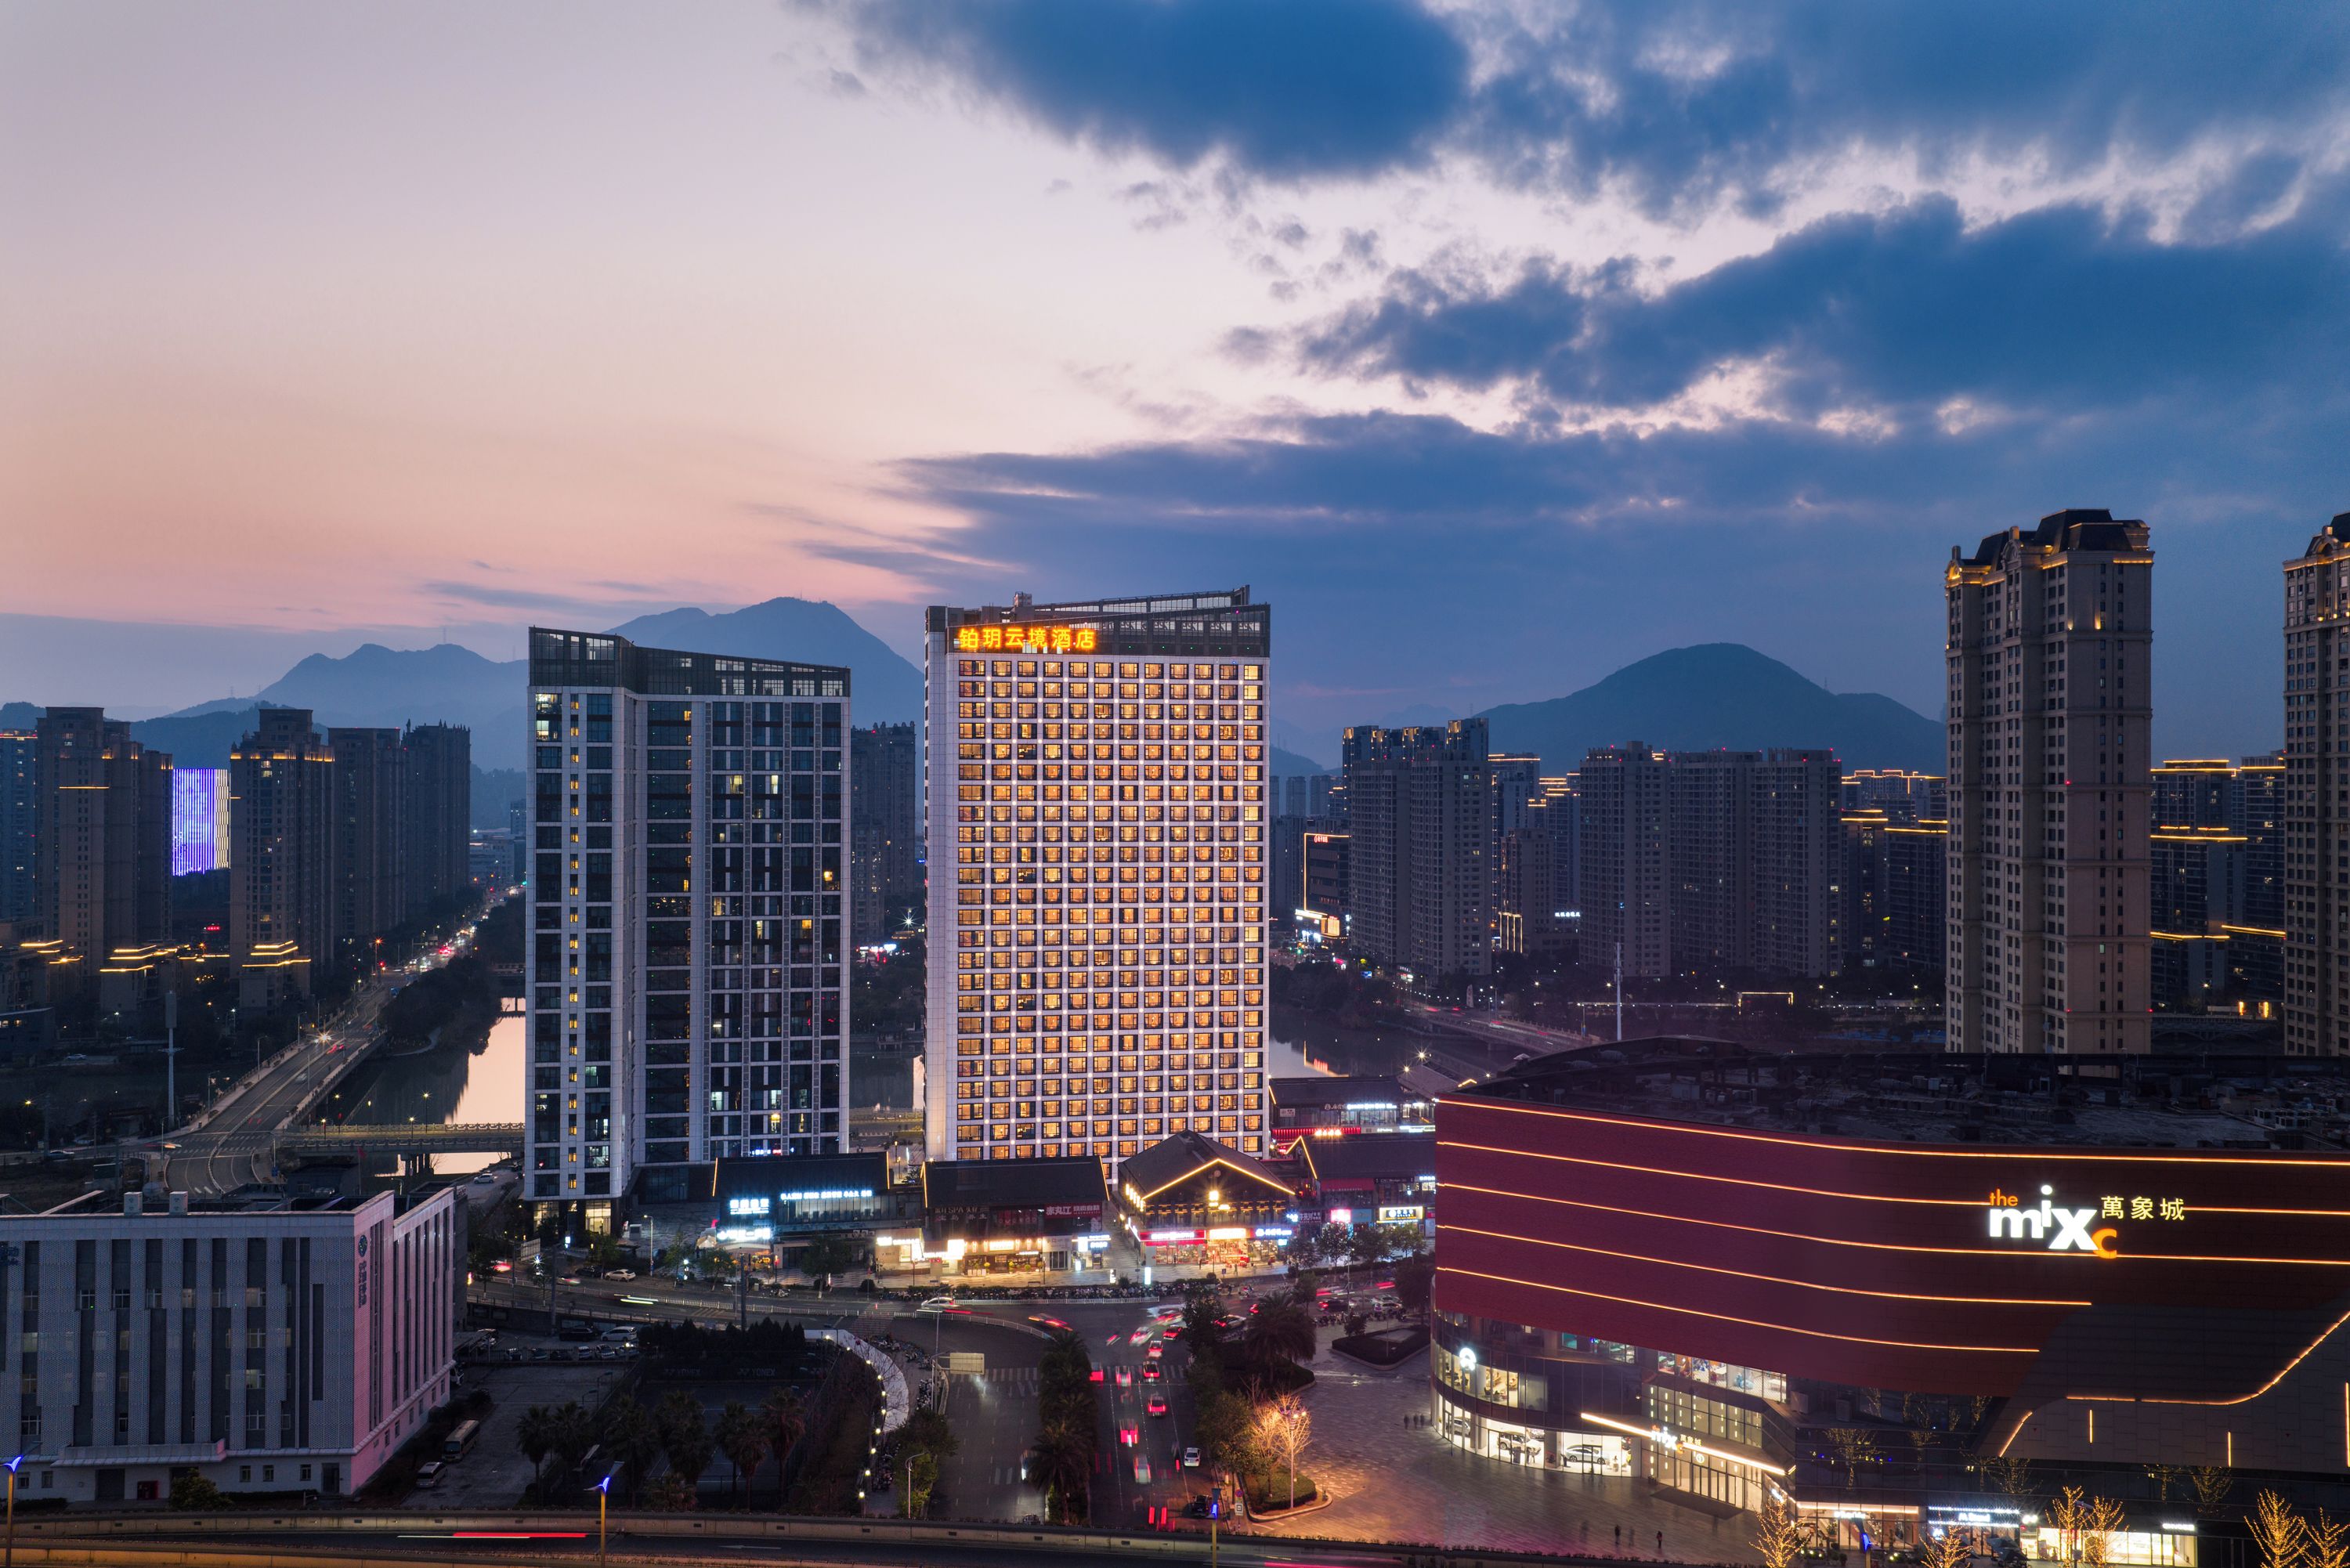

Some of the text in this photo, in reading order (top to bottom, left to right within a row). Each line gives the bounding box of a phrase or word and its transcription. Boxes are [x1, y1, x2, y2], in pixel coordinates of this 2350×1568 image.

[959, 627, 1095, 649] 铂玥云境酒店
[1990, 1188, 2019, 1207] the
[2100, 1195, 2186, 1221] 萬象城
[751, 1367, 776, 1377] YONEX
